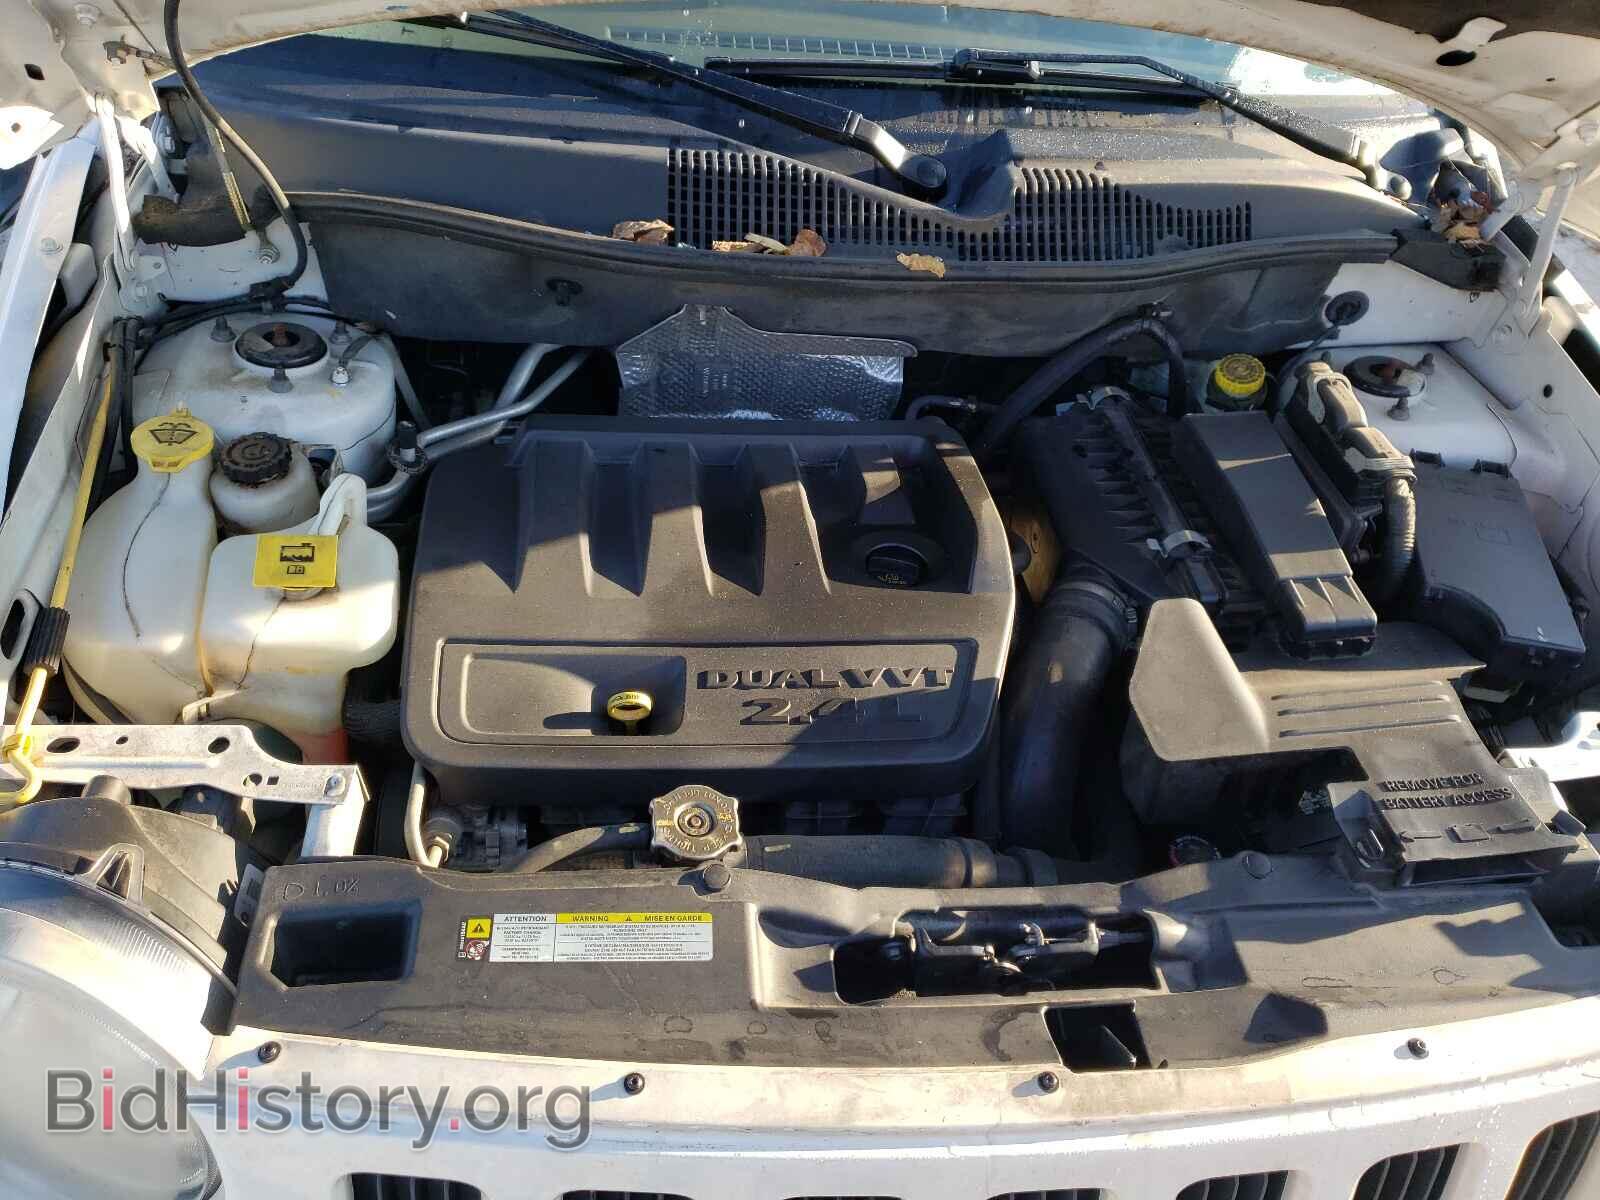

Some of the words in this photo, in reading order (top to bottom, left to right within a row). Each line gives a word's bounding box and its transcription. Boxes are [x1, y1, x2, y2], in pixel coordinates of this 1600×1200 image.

[697, 668, 840, 690] DUAL
[839, 666, 955, 689] VVT
[1381, 776, 1452, 792] REMOVE
[1454, 772, 1485, 788] FOR
[1381, 793, 1450, 810] BATTERY
[1452, 787, 1514, 807] ACCESS
